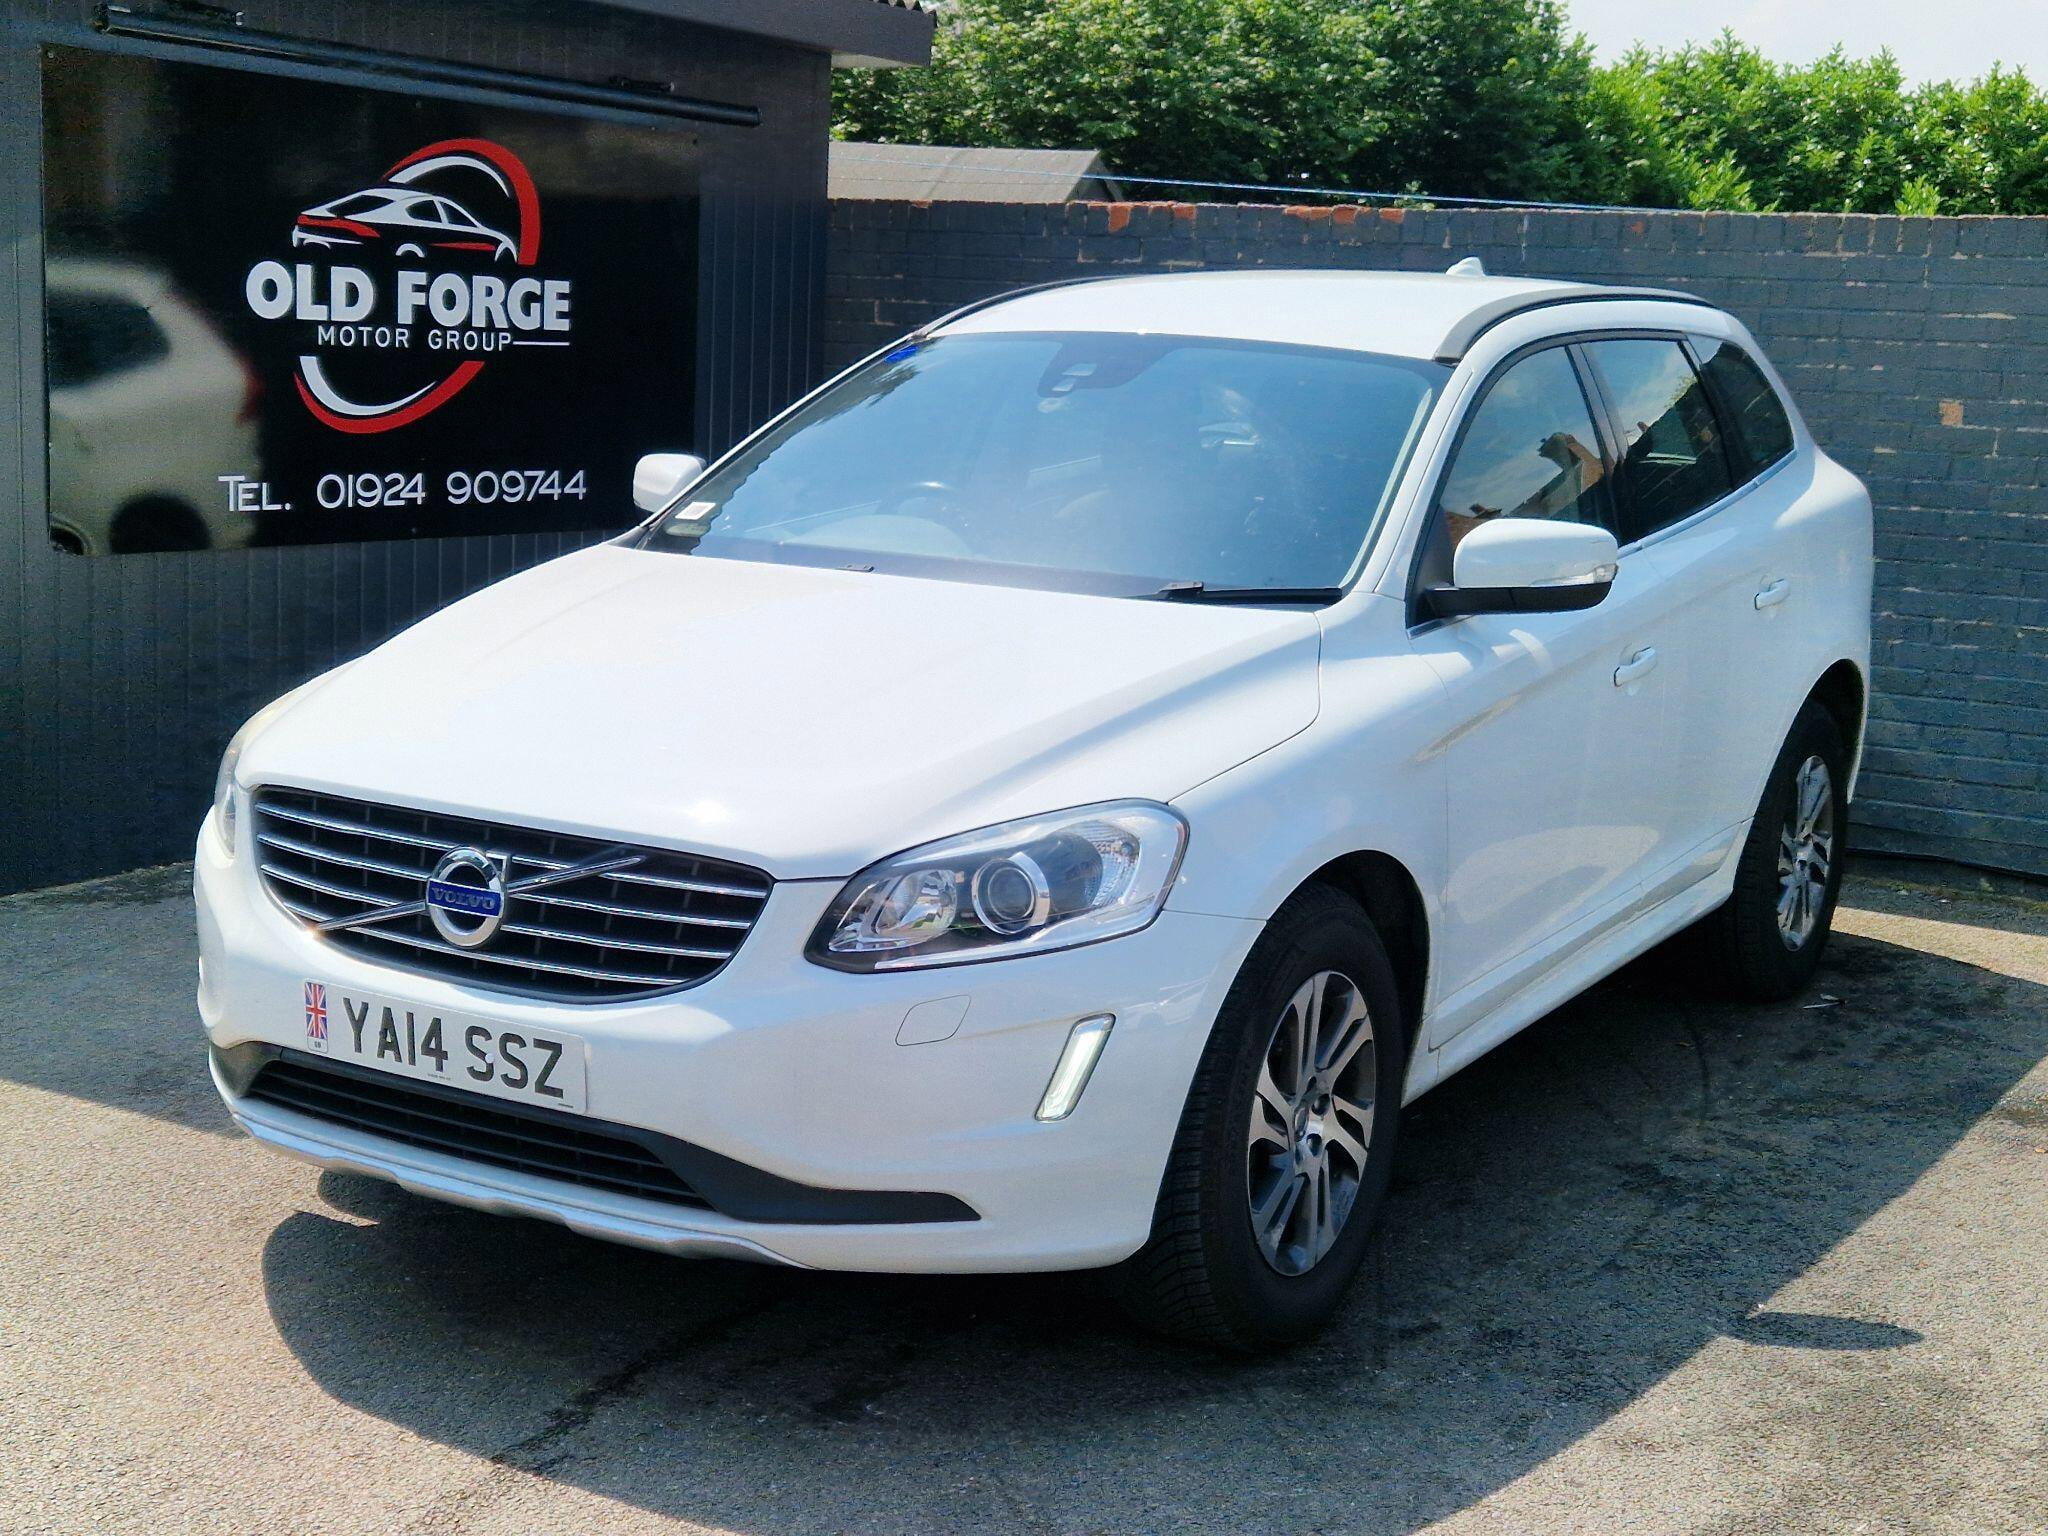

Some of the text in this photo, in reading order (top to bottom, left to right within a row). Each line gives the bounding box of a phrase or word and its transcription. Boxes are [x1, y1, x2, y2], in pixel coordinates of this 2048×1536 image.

[246, 260, 571, 331] OLD FORGE
[317, 325, 512, 351] MOTOR GROUP
[316, 473, 426, 508] 01924
[446, 470, 587, 505] 909744
[431, 887, 496, 910] VOLVO
[342, 997, 564, 1099] YA14 SSZ
